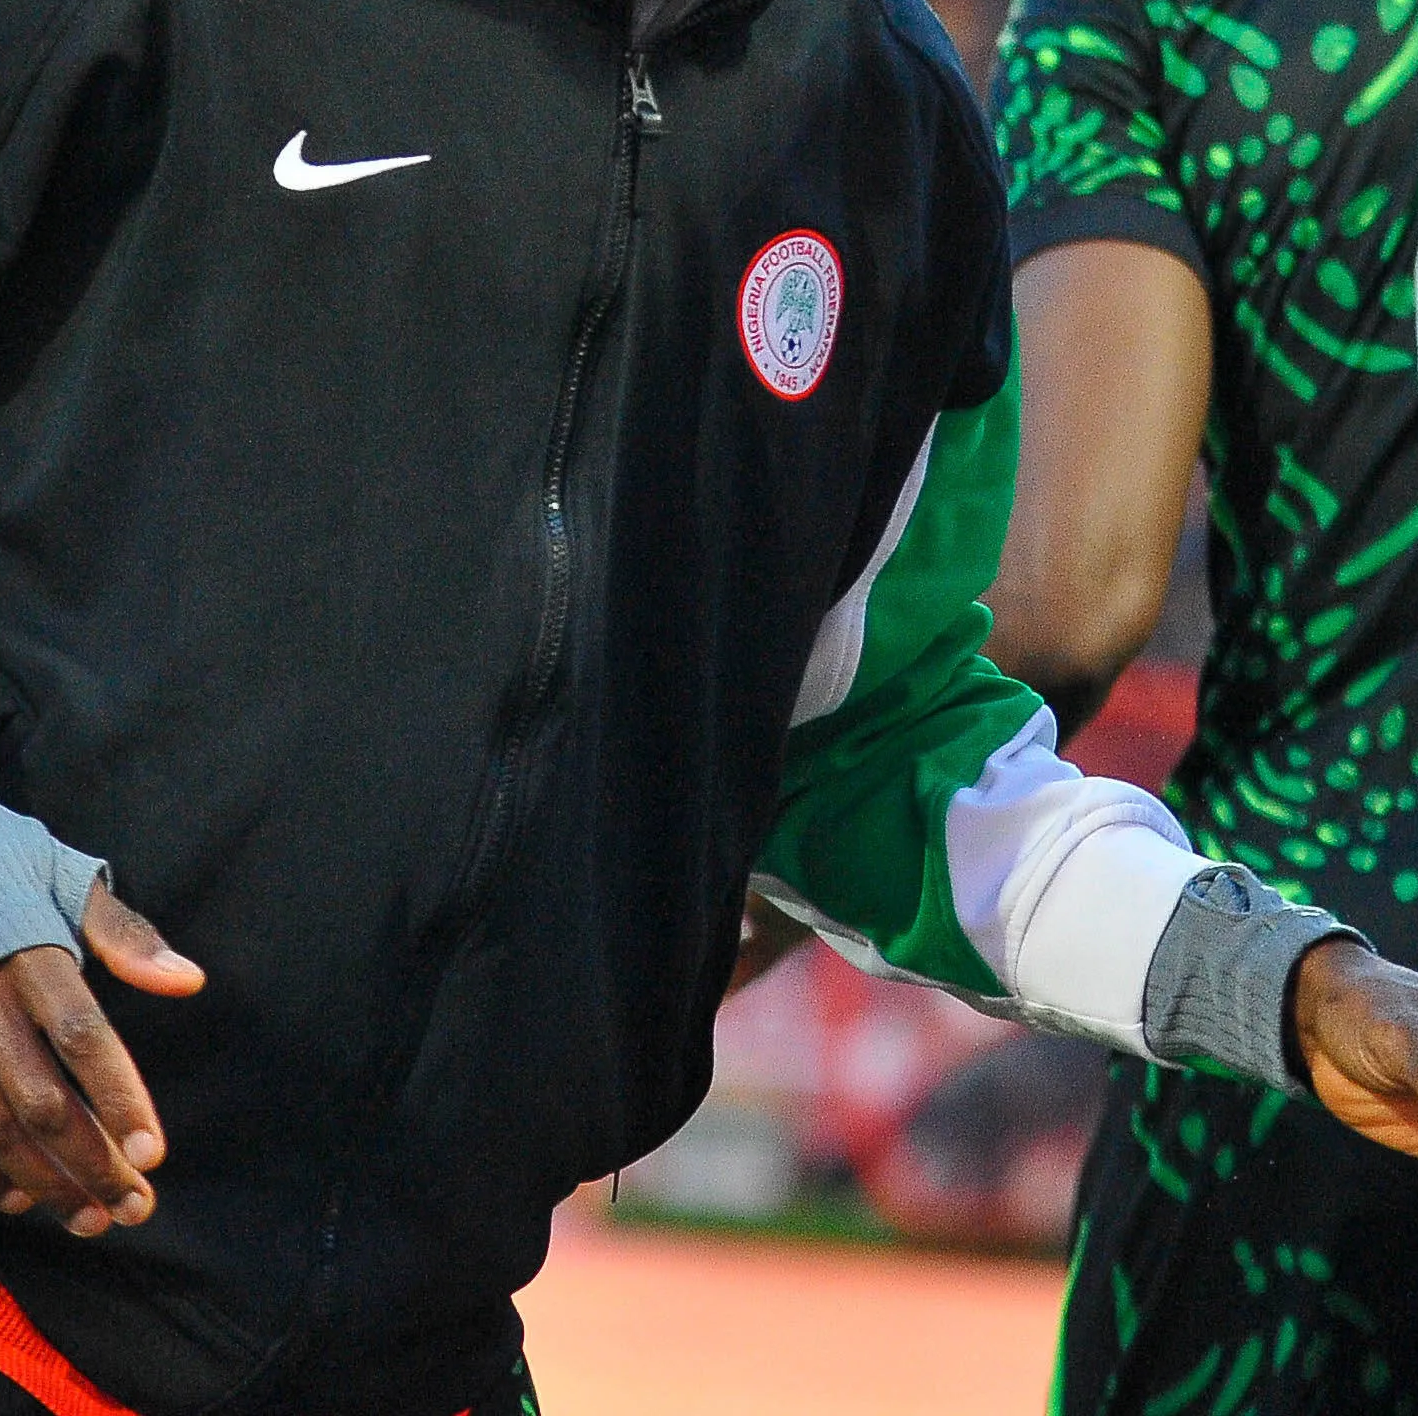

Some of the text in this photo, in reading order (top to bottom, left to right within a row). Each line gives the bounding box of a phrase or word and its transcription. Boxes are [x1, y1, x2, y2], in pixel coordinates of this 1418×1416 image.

[746, 240, 838, 379] NIGERIA FOOTBALL FEDERATION
[773, 369, 799, 391] 1945
